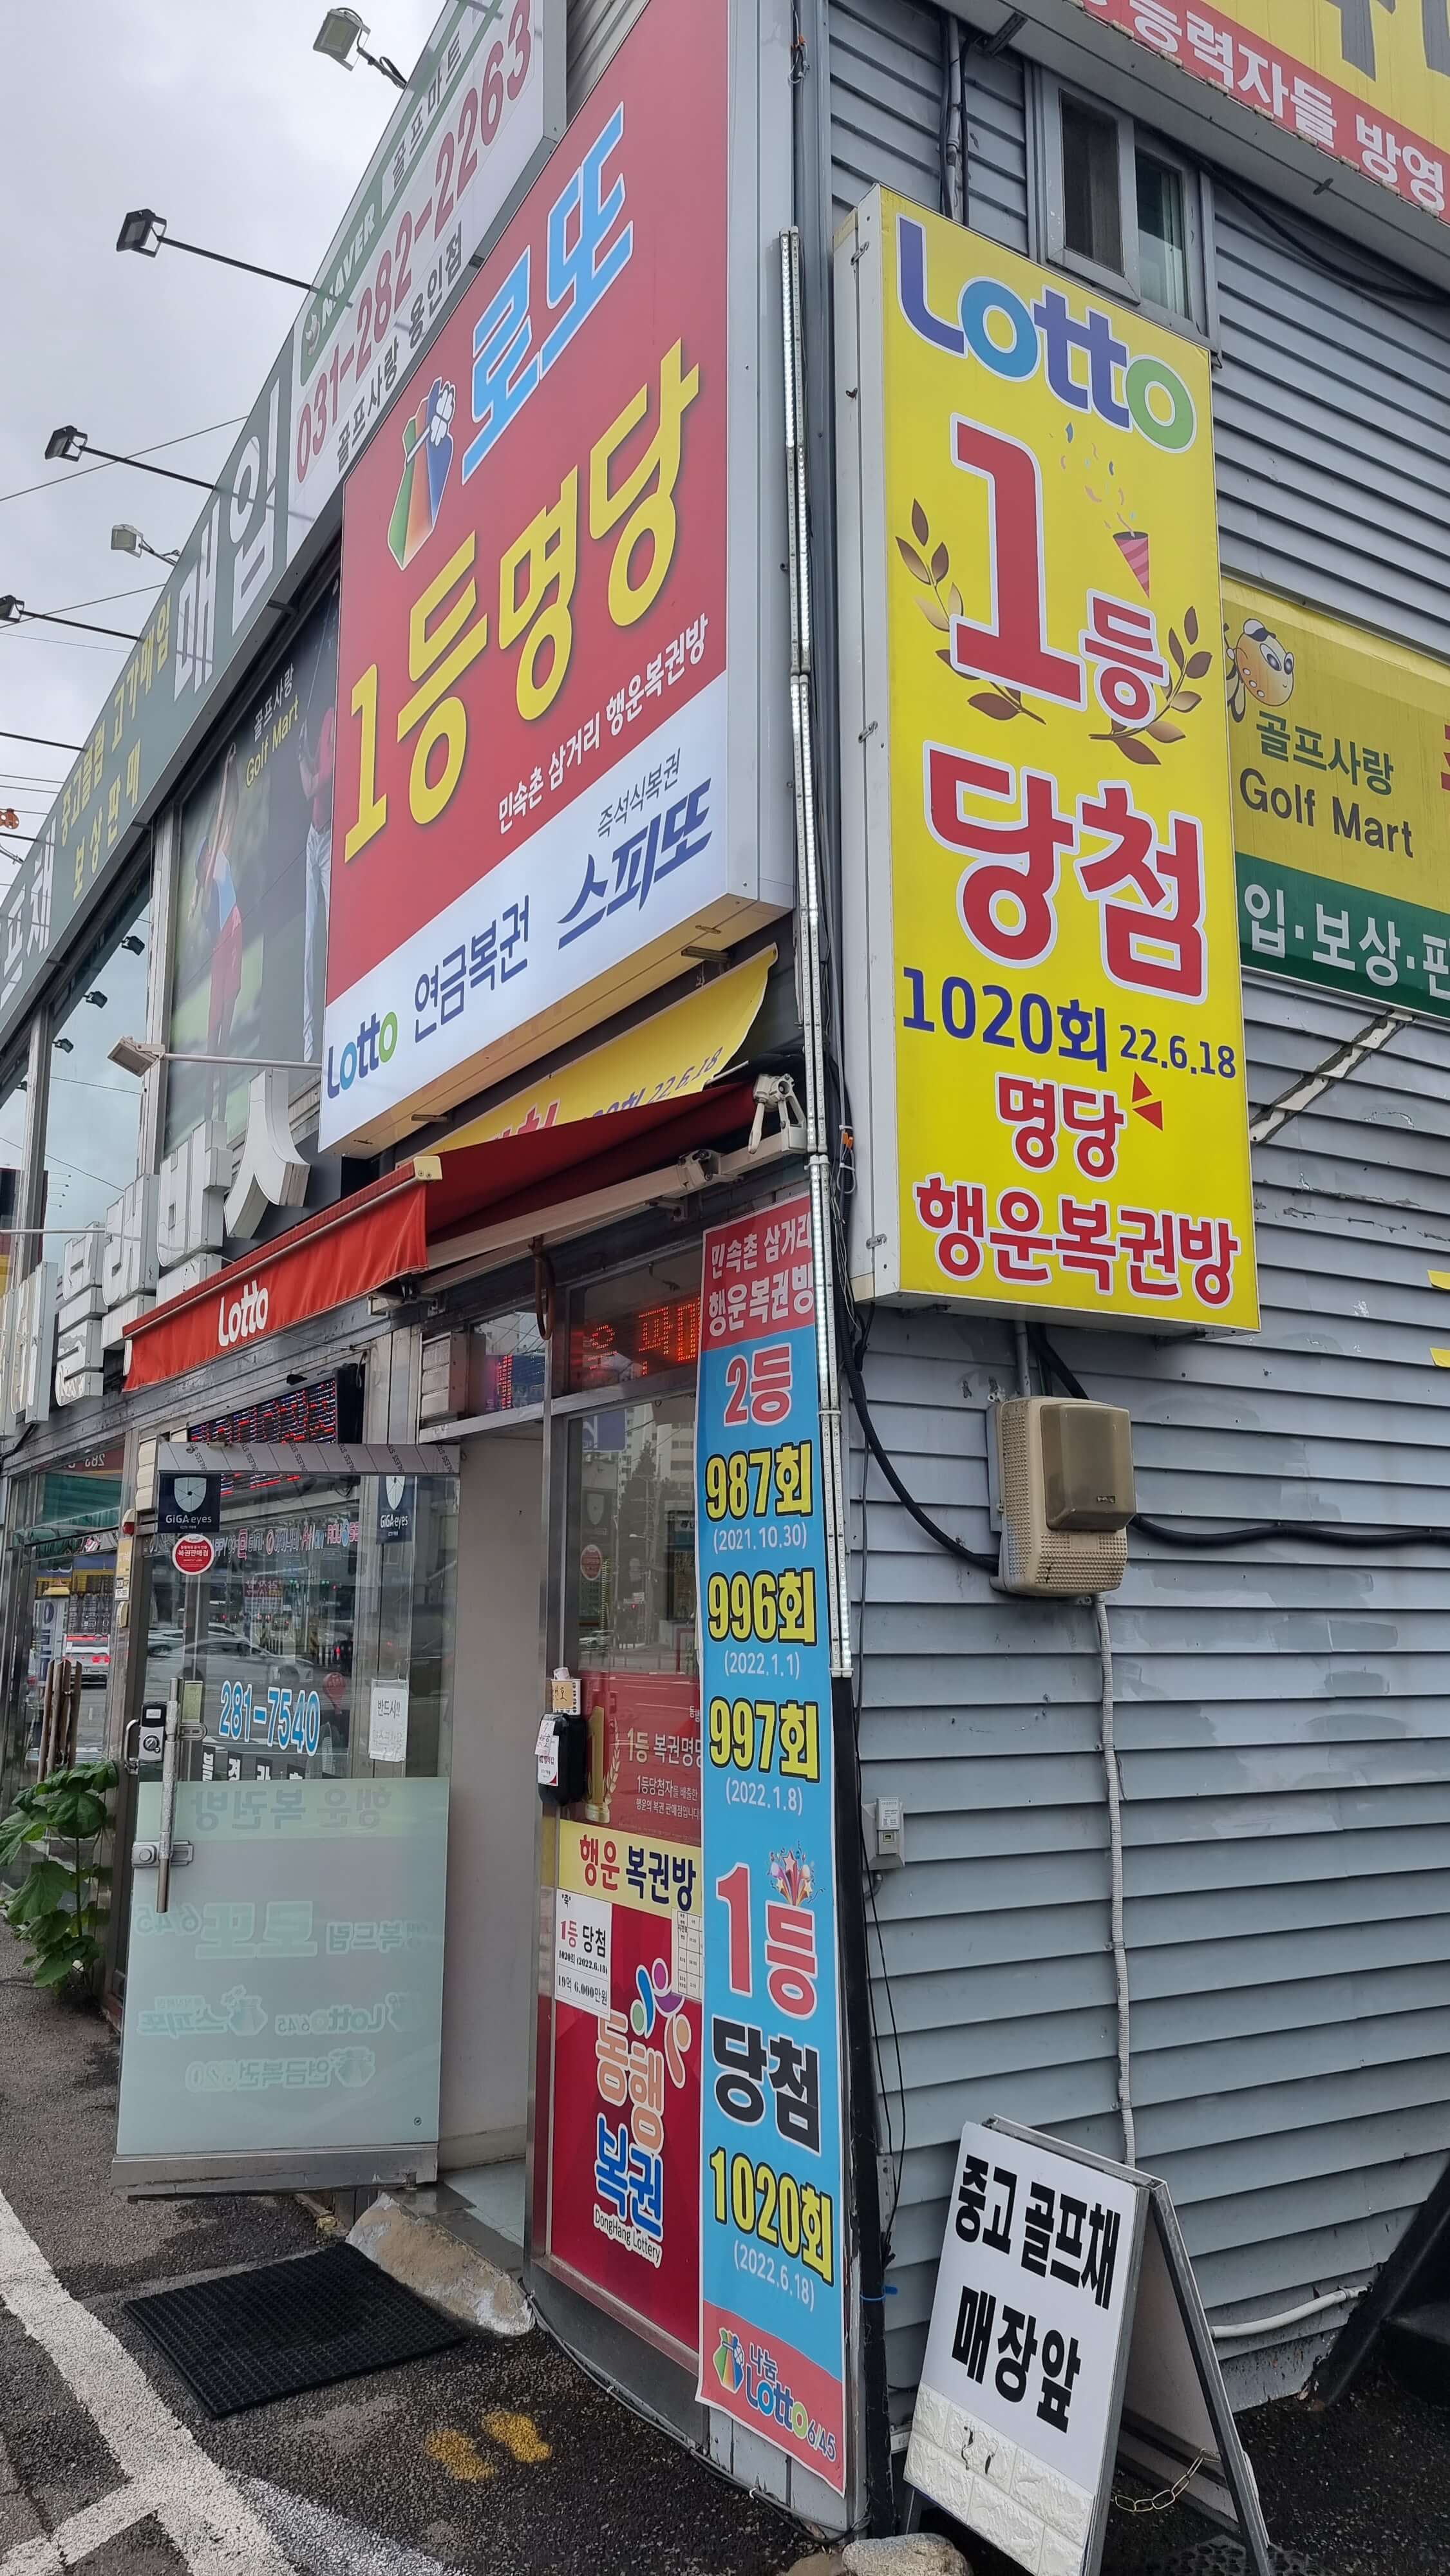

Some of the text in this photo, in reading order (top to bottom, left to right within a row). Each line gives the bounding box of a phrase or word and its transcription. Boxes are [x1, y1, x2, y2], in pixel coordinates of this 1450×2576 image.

[1356, 114, 1445, 211] 방영
[297, 0, 531, 483] 031-282-2263
[321, 203, 375, 330] NAVER
[462, 100, 634, 486] 로또
[896, 213, 1196, 453] Lotto
[337, 221, 462, 474] 골프사랑 용인점
[174, 378, 280, 702] 매입
[950, 413, 1170, 729] 1등
[111, 592, 171, 753] 고가매입
[254, 662, 294, 743] 골프사랑
[246, 694, 299, 787] Golf Mart
[498, 613, 709, 835] 민속촌 삼거리 행운복권방
[1256, 710, 1393, 796] 골프사랑
[598, 748, 682, 838] 즉석식복권
[1239, 767, 1415, 859] Golf Mart
[558, 778, 713, 951] 스피또
[923, 741, 1209, 1005] 당첨
[414, 895, 531, 1044] 연금복권
[326, 1010, 398, 1099] Lotto
[903, 967, 1237, 1079] 1020회 22.6.18
[995, 1072, 1126, 1182] 명당
[711, 1211, 813, 1280] 민속촌 삼거리
[913, 1172, 1240, 1309] 행운복권방
[218, 1281, 269, 1347] Lotto
[723, 1343, 793, 1427] 2등
[165, 1514, 212, 1526] GiGA eyes
[380, 1514, 408, 1530] GiGA eyes
[706, 1439, 813, 1522] 987회
[707, 1567, 817, 1647] 996회
[219, 1680, 321, 1757] 281-7540
[377, 1698, 400, 1719] 반드시!!
[627, 1727, 650, 1764] 1등
[709, 1696, 820, 1783] 997회
[636, 1798, 652, 1812] 행운의
[653, 1801, 664, 1815] 복권
[637, 1775, 698, 1801] 1등당첨자를 배출한
[579, 1833, 697, 1913] 행운 복권방
[558, 1949, 608, 1975] 1020회 (2022.6.18)
[560, 1920, 607, 1958] 1등 당첨
[716, 1862, 818, 2020] 1등
[558, 1975, 572, 1994] 19억
[712, 2013, 821, 2157] 당첨
[594, 2112, 664, 2242] 복권
[710, 2145, 835, 2287] 1020회
[595, 2208, 660, 2264] DongHang Lottery
[733, 2239, 815, 2312] (2022.6.18)
[749, 2341, 778, 2380] 나눔
[746, 2368, 836, 2463] Lotto 6/45
